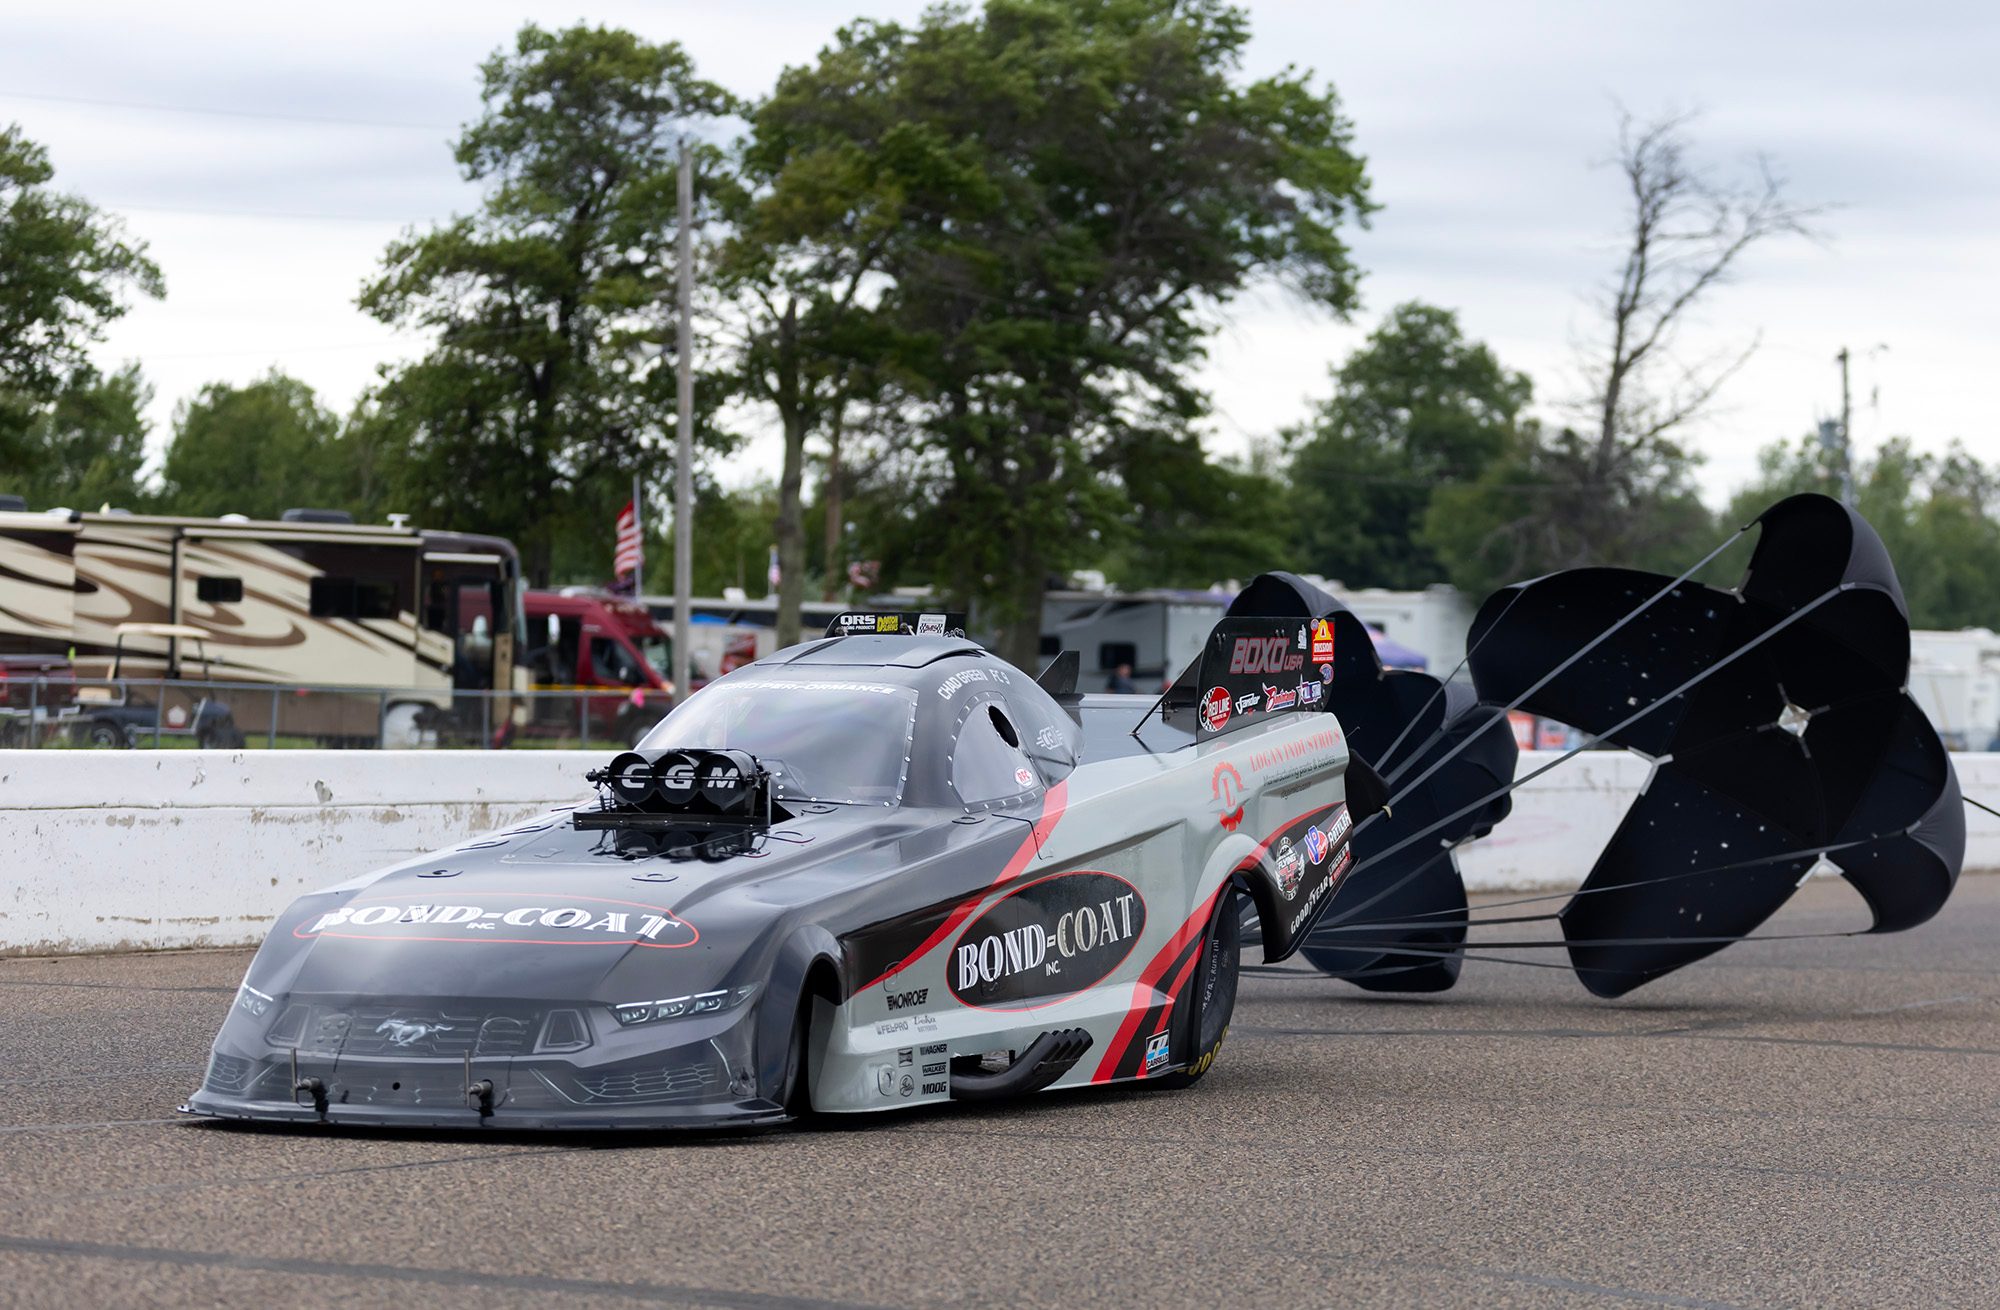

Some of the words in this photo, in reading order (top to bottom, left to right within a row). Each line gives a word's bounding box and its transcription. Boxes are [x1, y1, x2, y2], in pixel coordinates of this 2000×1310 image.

[840, 614, 876, 626] QRS
[1229, 637, 1290, 674] BOXO
[1283, 654, 1304, 671] USA
[937, 676, 963, 700] CHAD
[956, 668, 989, 684] GREEN
[1208, 701, 1219, 717] RED
[1218, 697, 1231, 713] LINE
[1249, 747, 1284, 772] LOGAN
[308, 904, 681, 941] BOND-COAT
[958, 892, 1135, 991] BOND-COAT
[887, 988, 928, 1011] MONROE
[924, 1043, 948, 1055] WAGNER
[923, 1064, 946, 1074] WALKER
[1146, 1053, 1169, 1068] CARRILLO
[921, 1081, 947, 1096] MOOG
